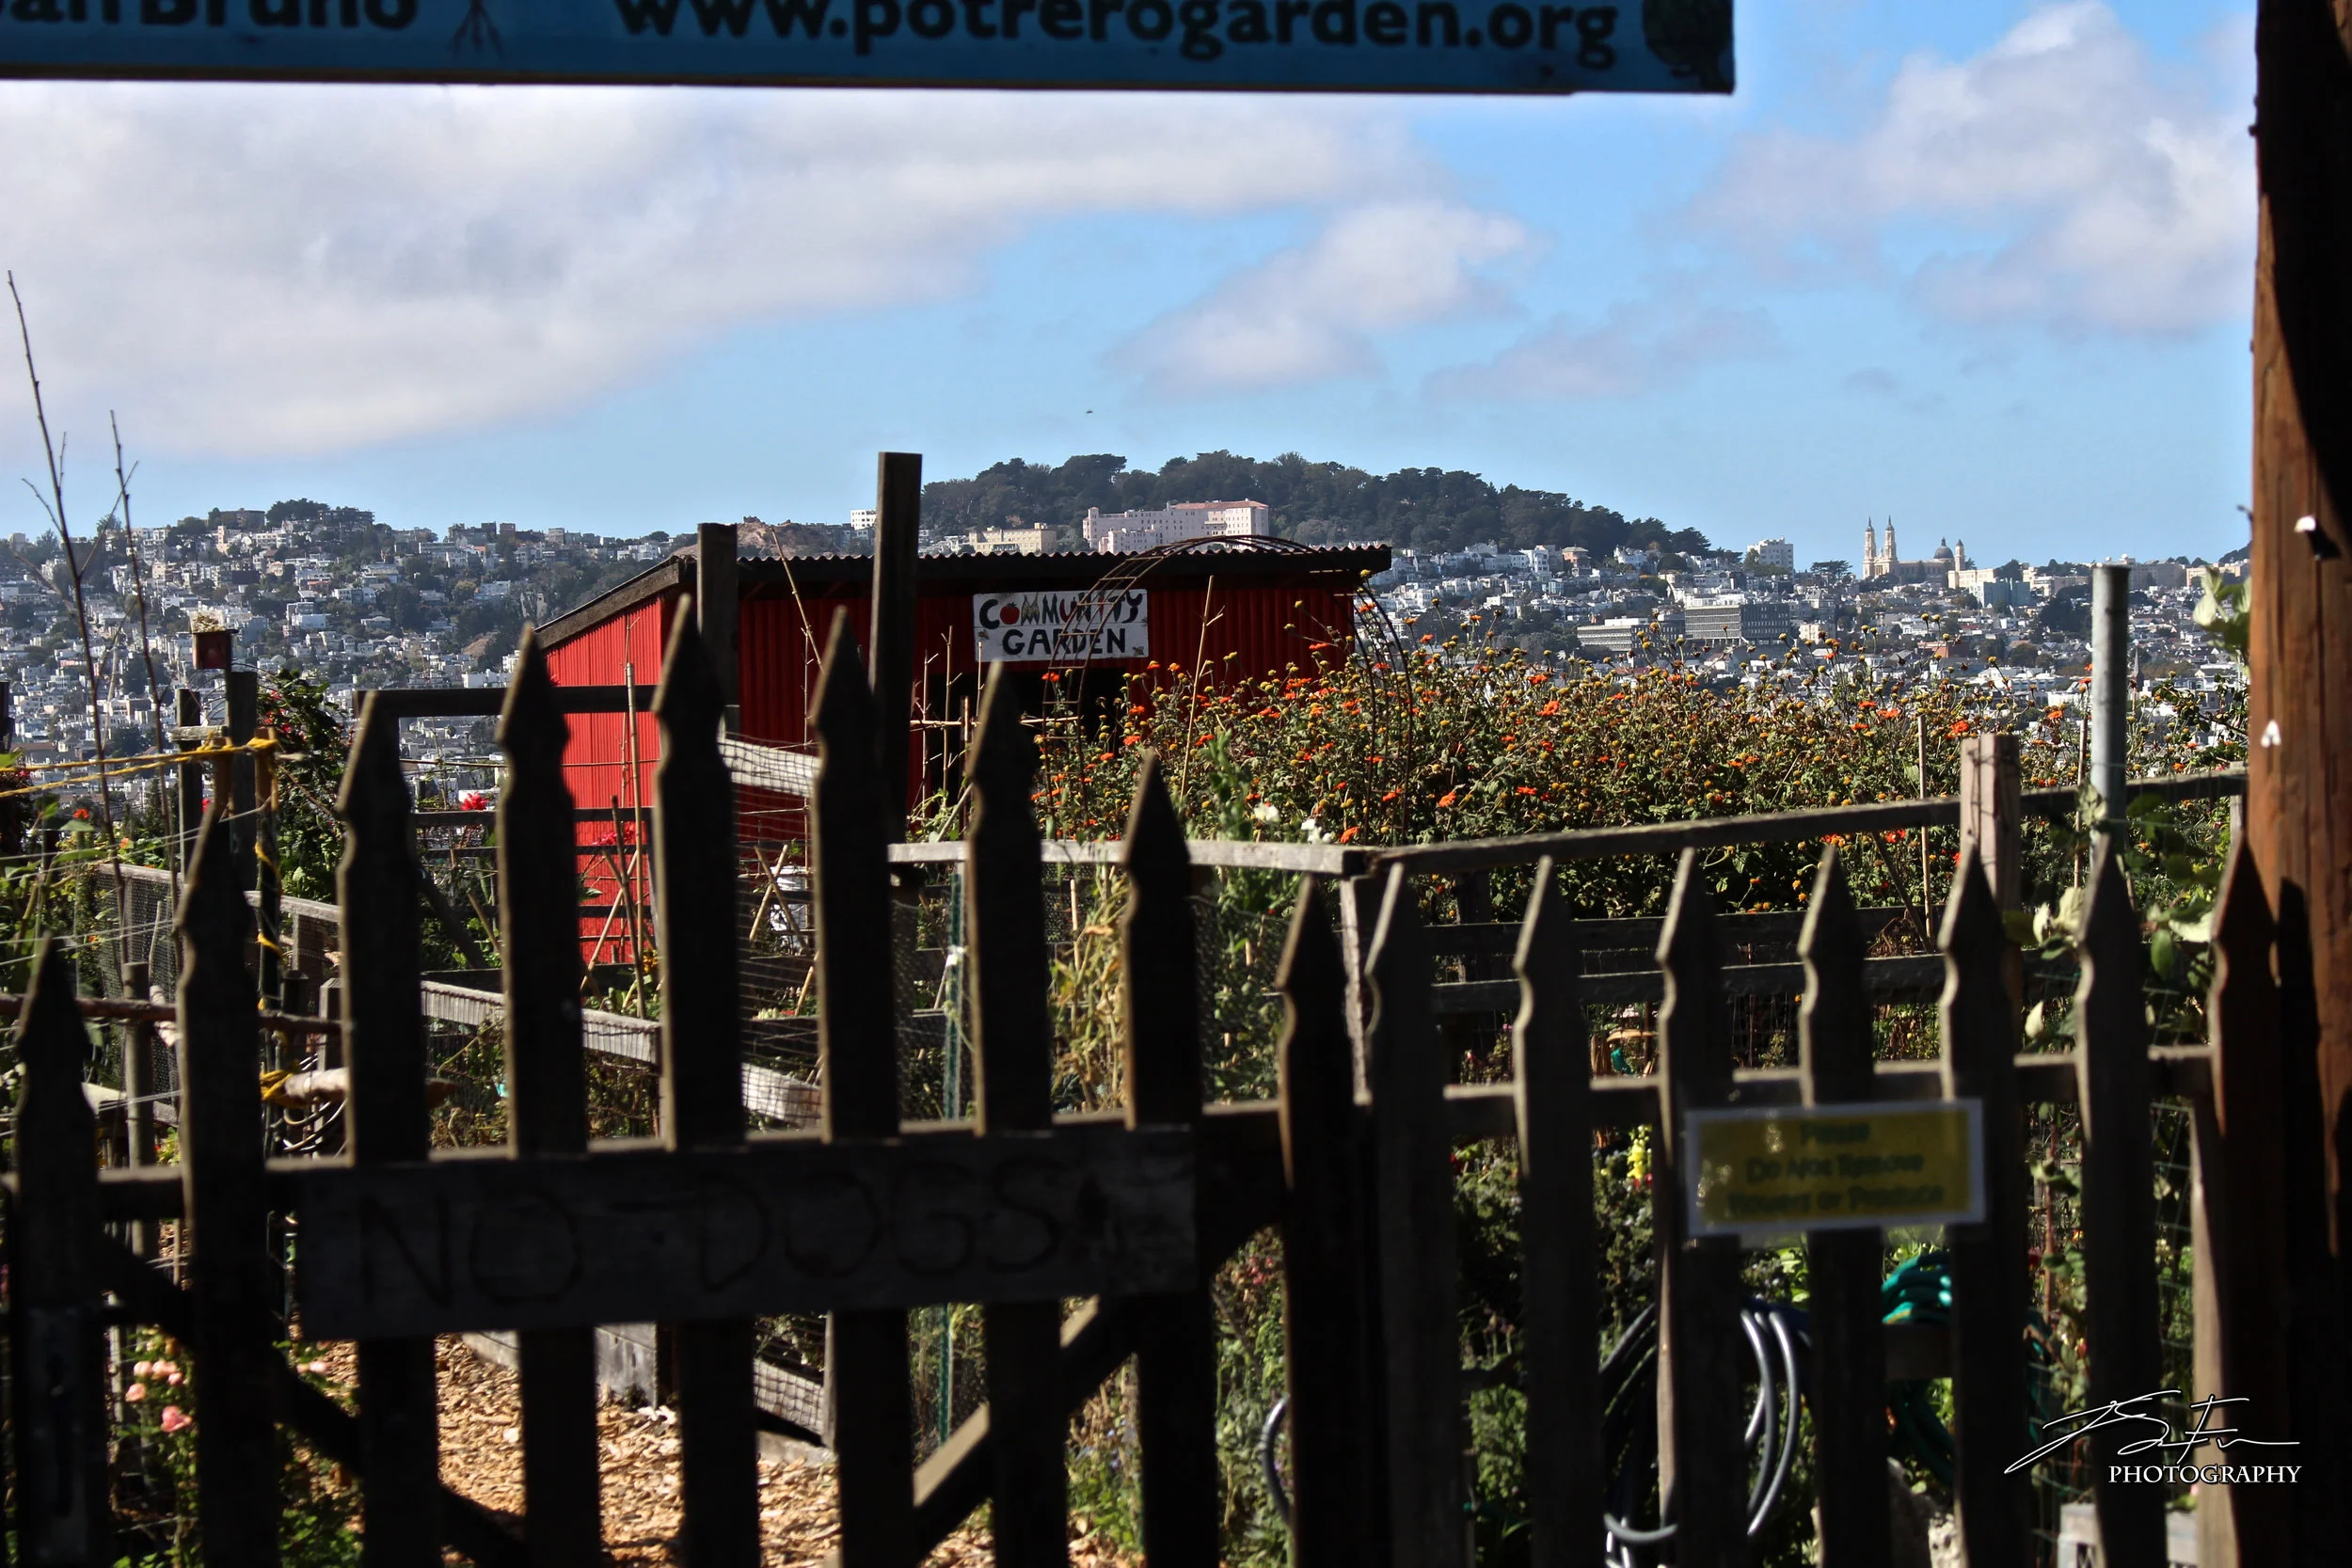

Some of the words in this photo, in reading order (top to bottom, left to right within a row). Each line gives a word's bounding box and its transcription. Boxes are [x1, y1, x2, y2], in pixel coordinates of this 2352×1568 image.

[615, 0, 1617, 70] www.potrerogarden.org
[979, 593, 1143, 629] COMMUNITY
[1002, 627, 1126, 656] GARDEN
